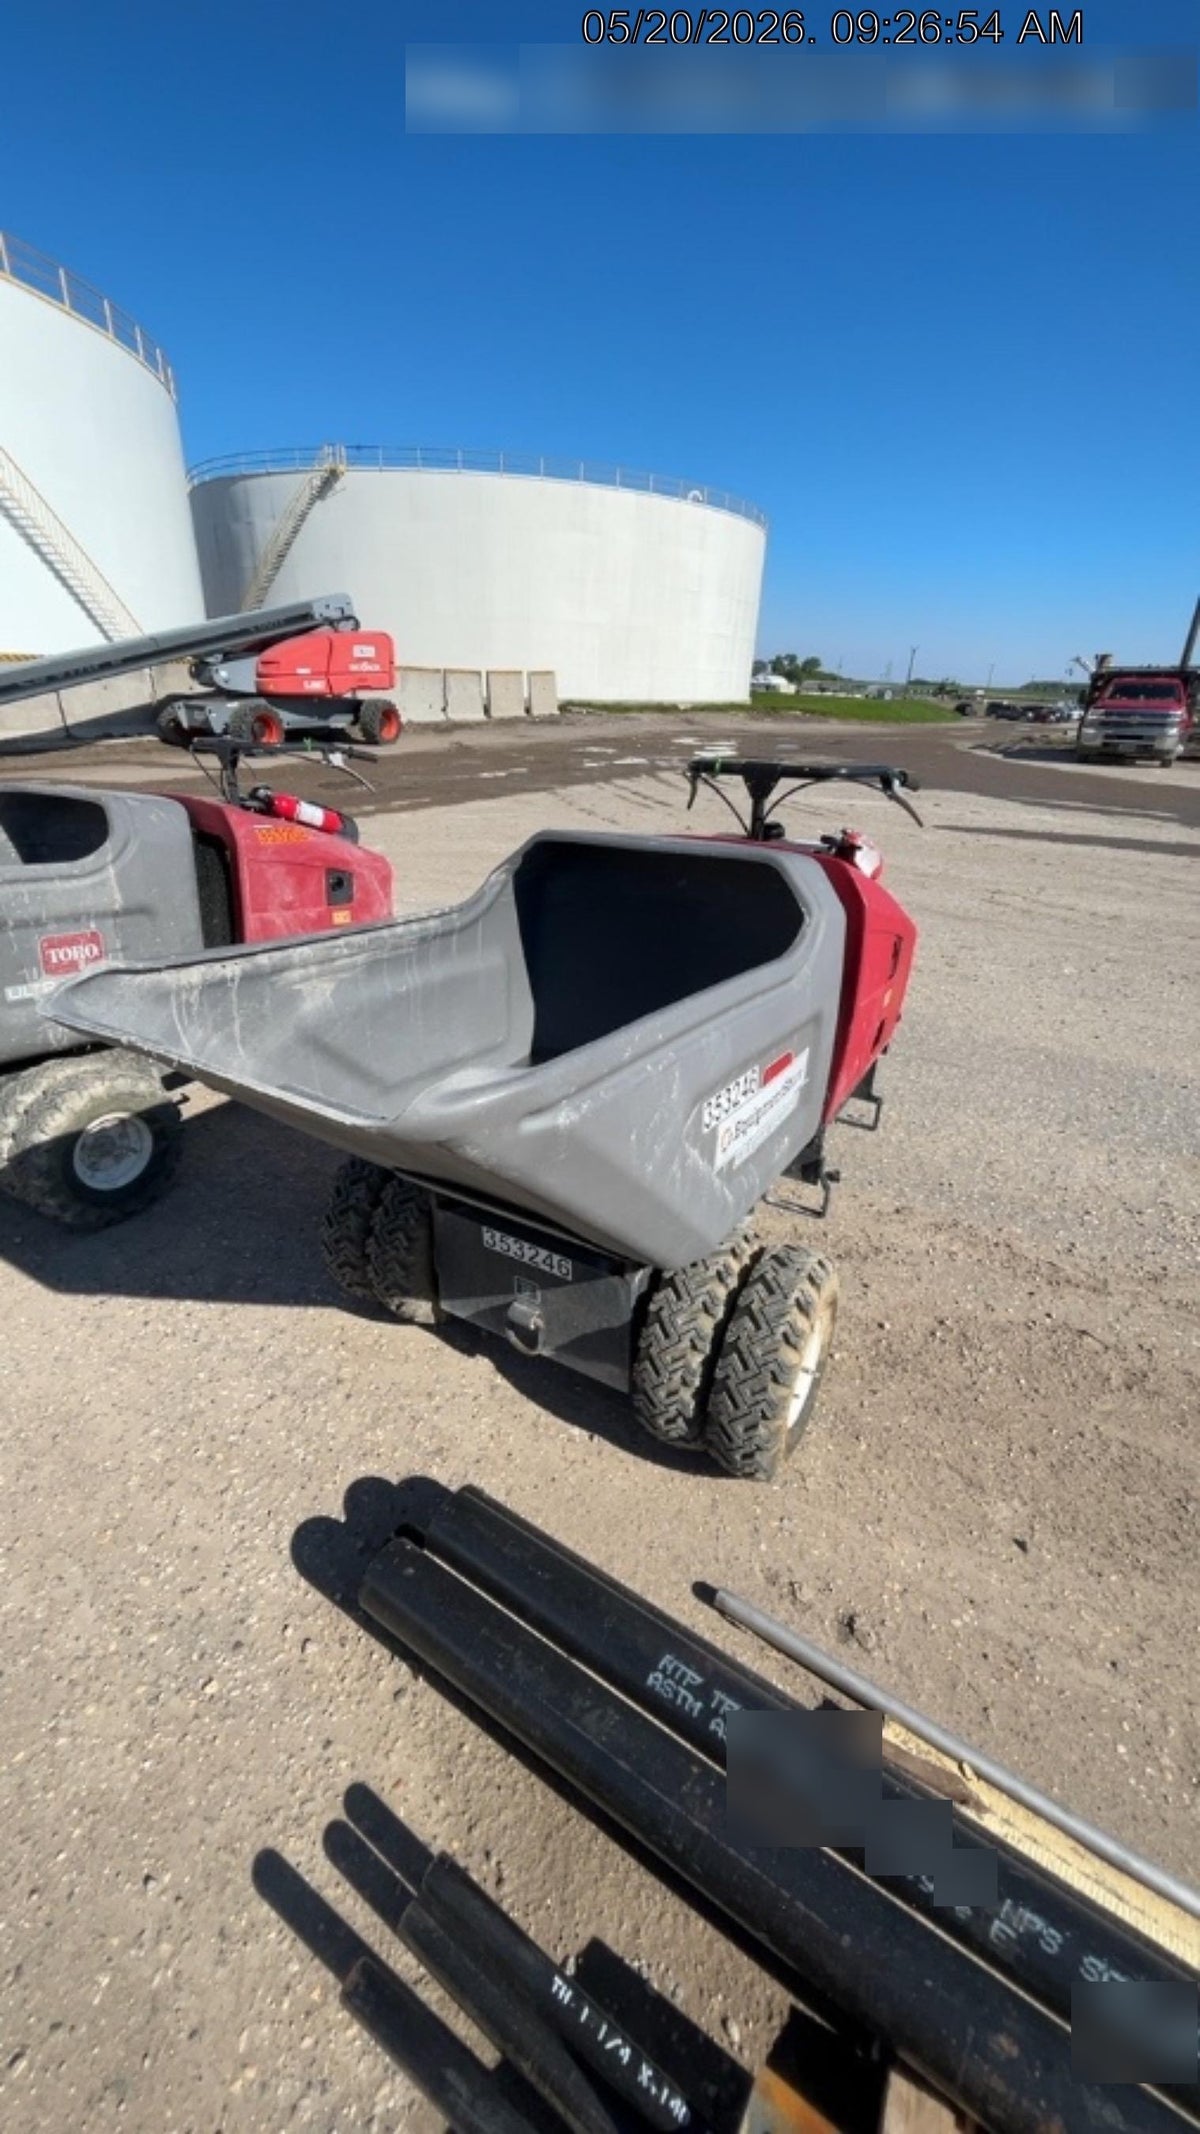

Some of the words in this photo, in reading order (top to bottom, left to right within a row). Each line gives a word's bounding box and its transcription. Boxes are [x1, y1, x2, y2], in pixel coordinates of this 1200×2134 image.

[49, 943, 99, 964] TORO
[482, 1226, 571, 1280] 353246
[646, 1670, 703, 1719] ASTM
[1000, 1898, 1064, 1955] NPS
